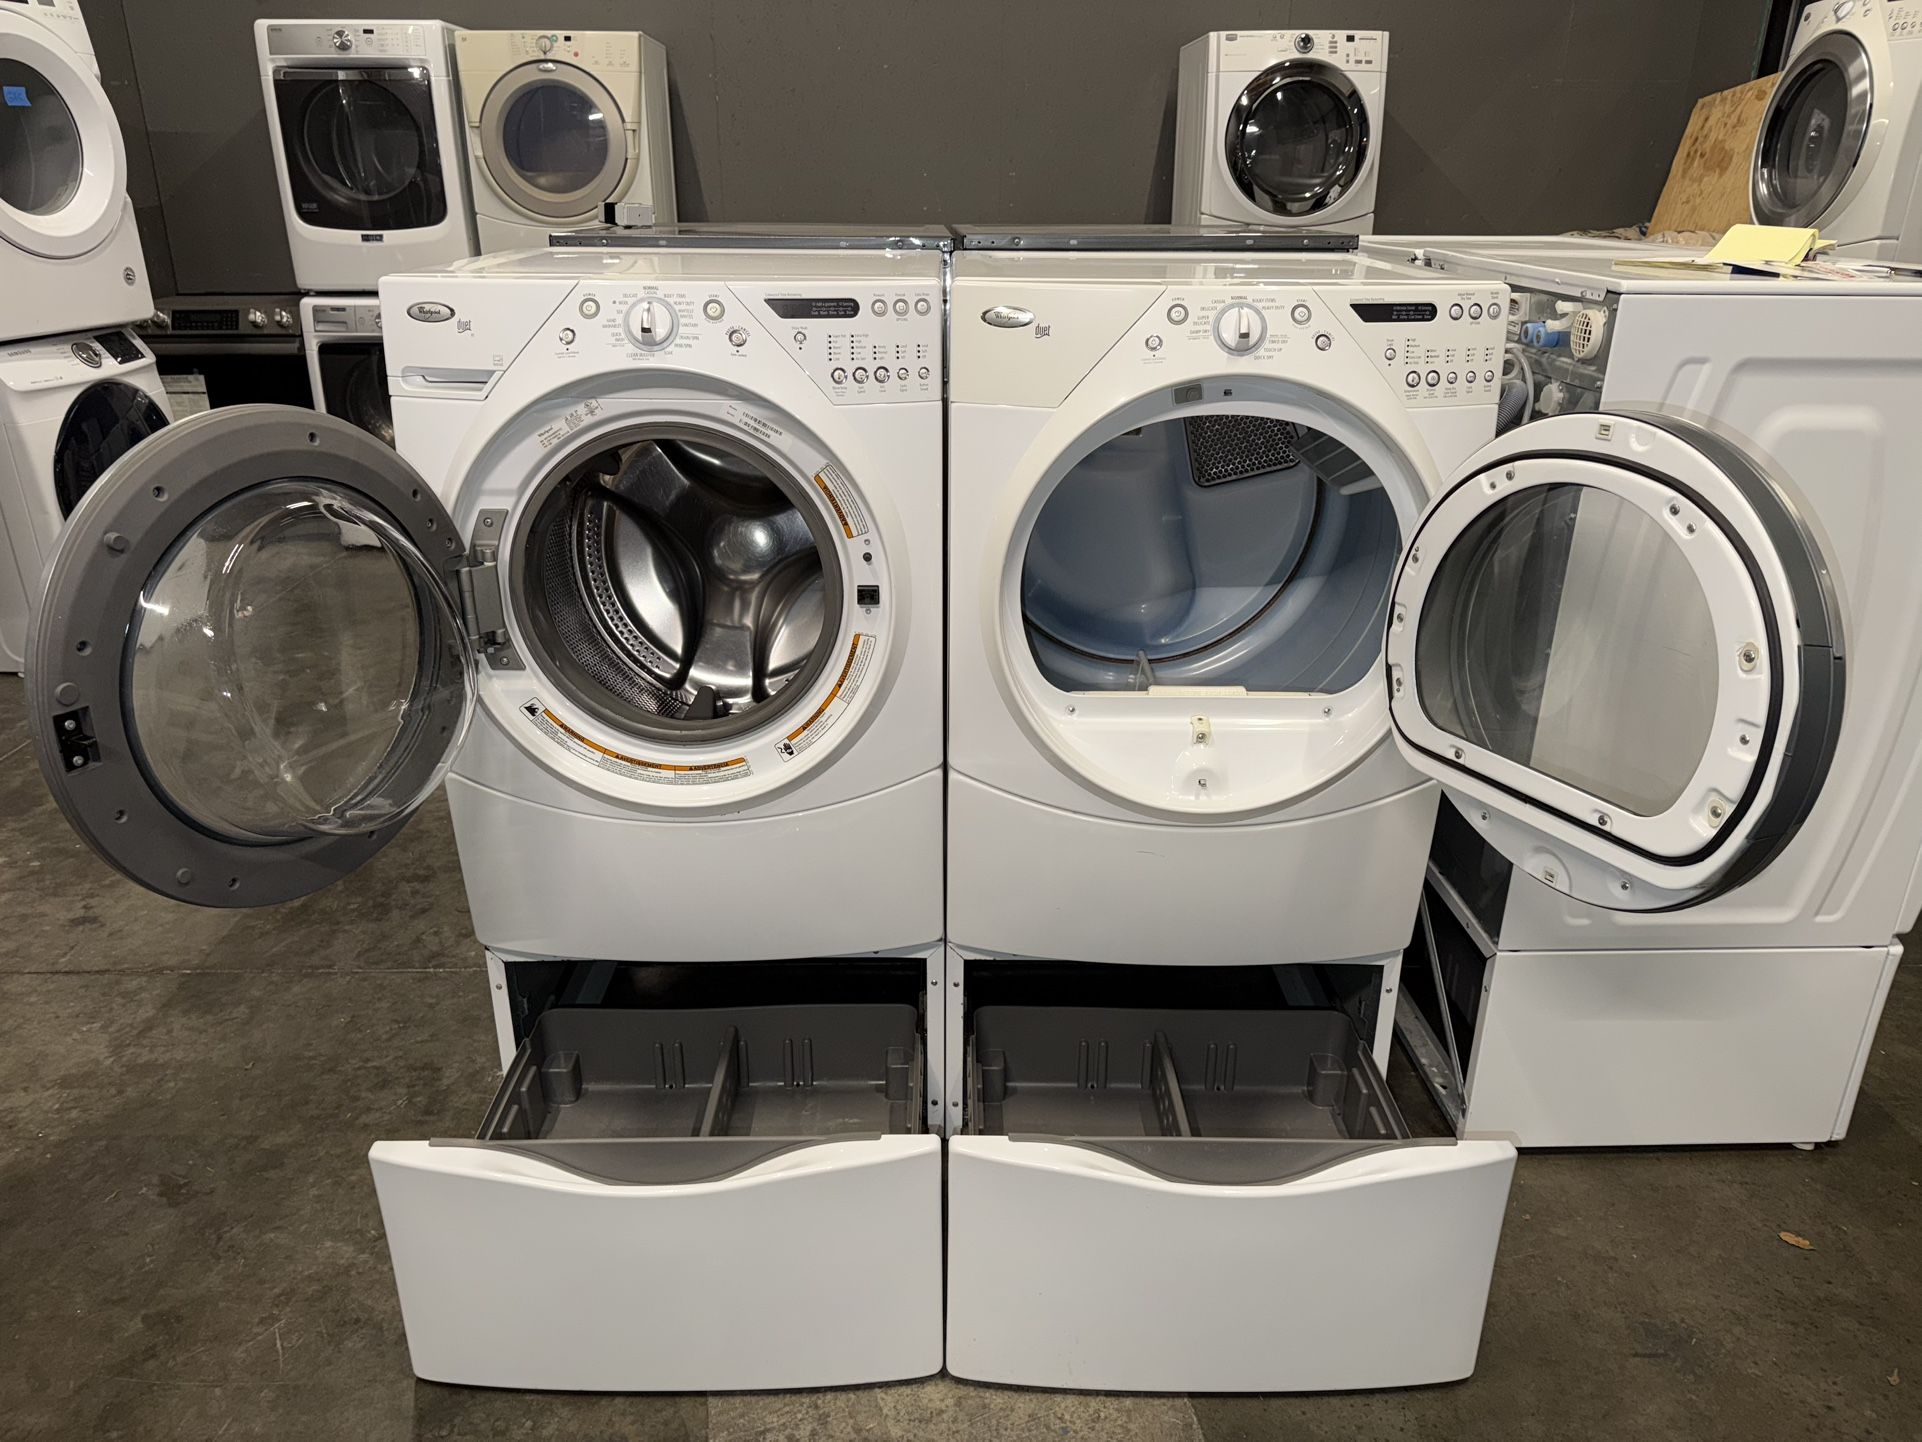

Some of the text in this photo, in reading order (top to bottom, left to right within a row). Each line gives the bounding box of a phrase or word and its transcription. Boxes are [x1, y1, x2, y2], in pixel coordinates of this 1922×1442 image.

[457, 318, 472, 333] duet
[1034, 323, 1051, 339] duet
[805, 708, 825, 729] WARNING
[563, 725, 585, 742] WARNING
[619, 756, 662, 769] AVERTISSEMENT
[692, 762, 729, 771] ADVERTENCIA
